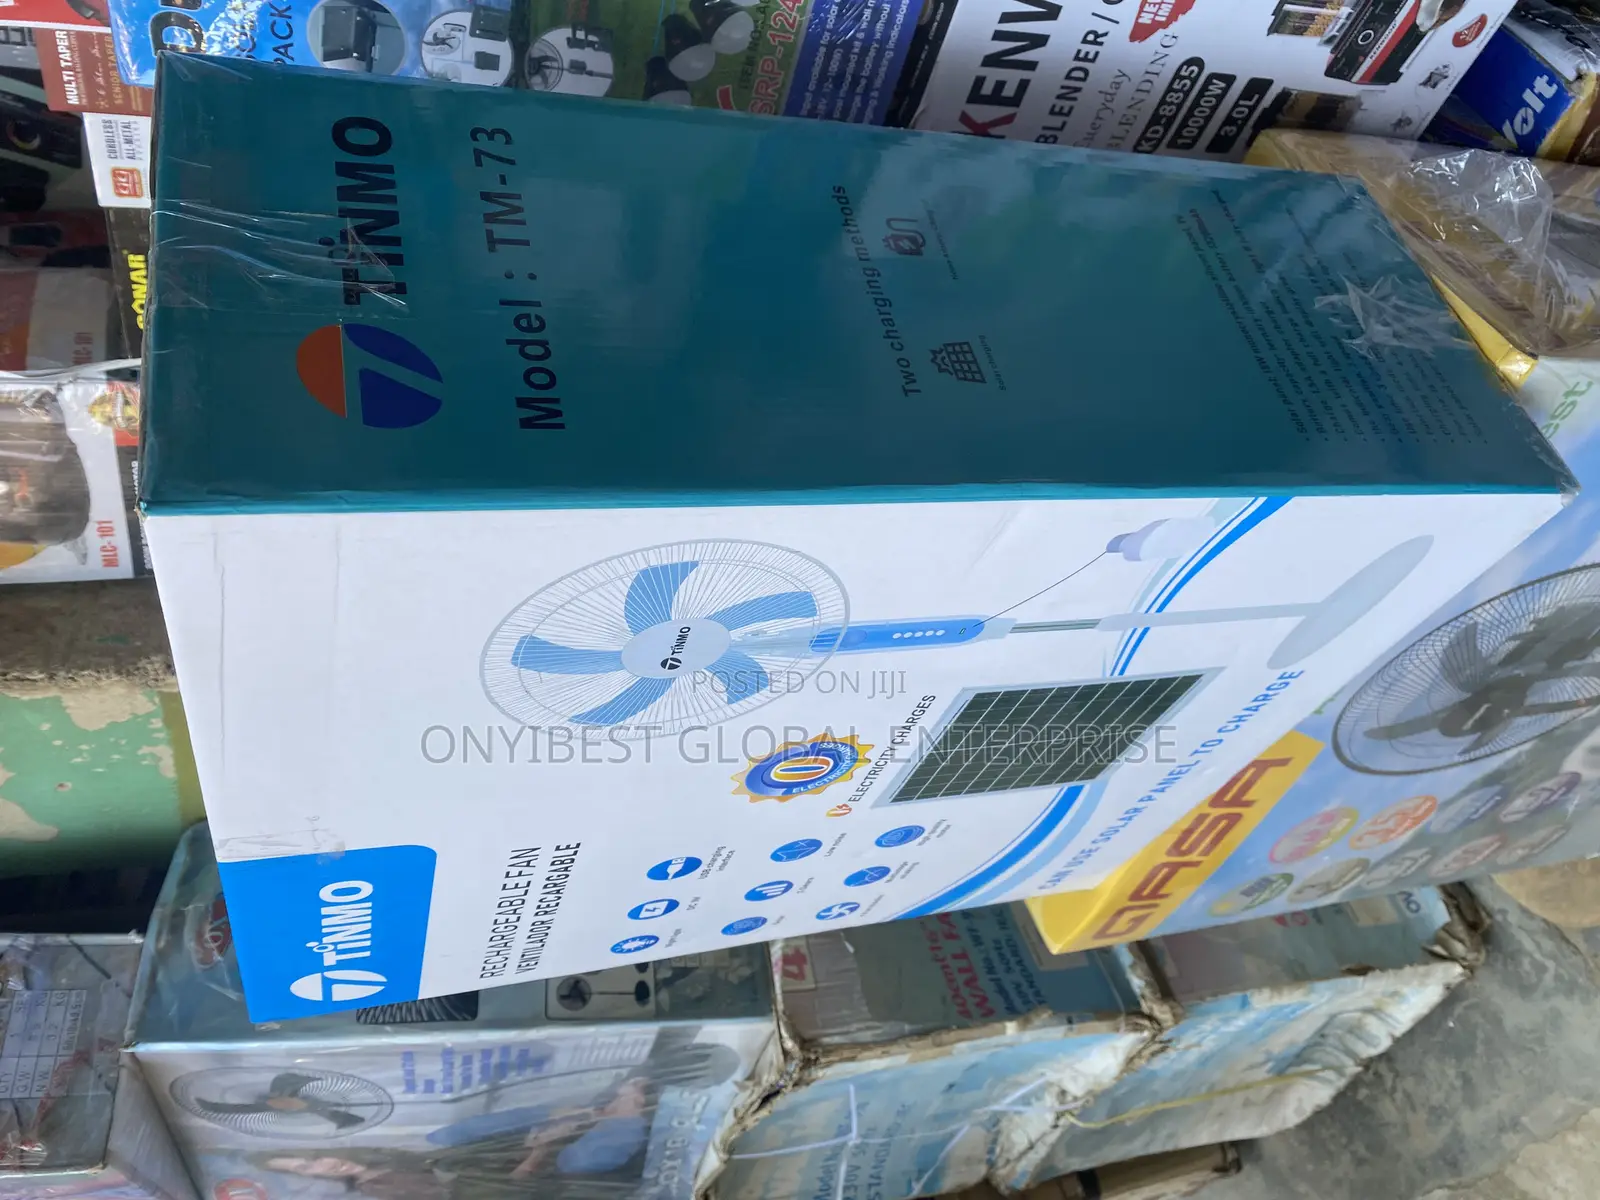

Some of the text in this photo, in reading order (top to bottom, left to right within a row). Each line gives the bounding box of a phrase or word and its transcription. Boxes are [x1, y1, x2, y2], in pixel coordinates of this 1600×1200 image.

[824, 4, 840, 30] solar
[855, 31, 866, 40] &
[858, 8, 873, 30] wall
[884, 0, 910, 49] indicators
[1137, 0, 1163, 25] NE
[1154, 0, 1176, 22] IM
[55, 29, 73, 68] TAPER
[819, 30, 832, 45] for
[849, 40, 863, 54] kit
[859, 42, 880, 77] battery
[872, 3, 892, 40] without
[62, 70, 80, 105] MULTI
[104, 34, 124, 105] SENIOR TAPER
[1034, 28, 1110, 146] BLENDER
[1137, 62, 1200, 152] KD-8855
[1177, 78, 1227, 146] 10000W
[1220, 91, 1261, 138] 3.0L
[101, 118, 119, 160] CORDLESS
[119, 119, 137, 161] ALL-METAL
[469, 126, 532, 254] TM-73
[830, 184, 923, 398] Two charging methods
[498, 297, 567, 430] Model
[978, 334, 1008, 392] Solar charging
[1285, 408, 1308, 435] Solar
[95, 519, 120, 568] MLC- 101
[846, 694, 937, 802] ELECTRICITY CHARGES
[1037, 668, 1306, 892] CAN USE SOLAR PANEL TO CHARGE
[478, 846, 543, 980] RECHARGEABLE FAN
[514, 842, 582, 976] VENTILADOR RECARGABLE
[949, 948, 997, 1018] WALL
[976, 976, 1018, 1015] Model
[1004, 936, 1049, 1006] TANDARD:
[55, 992, 69, 1008] KG
